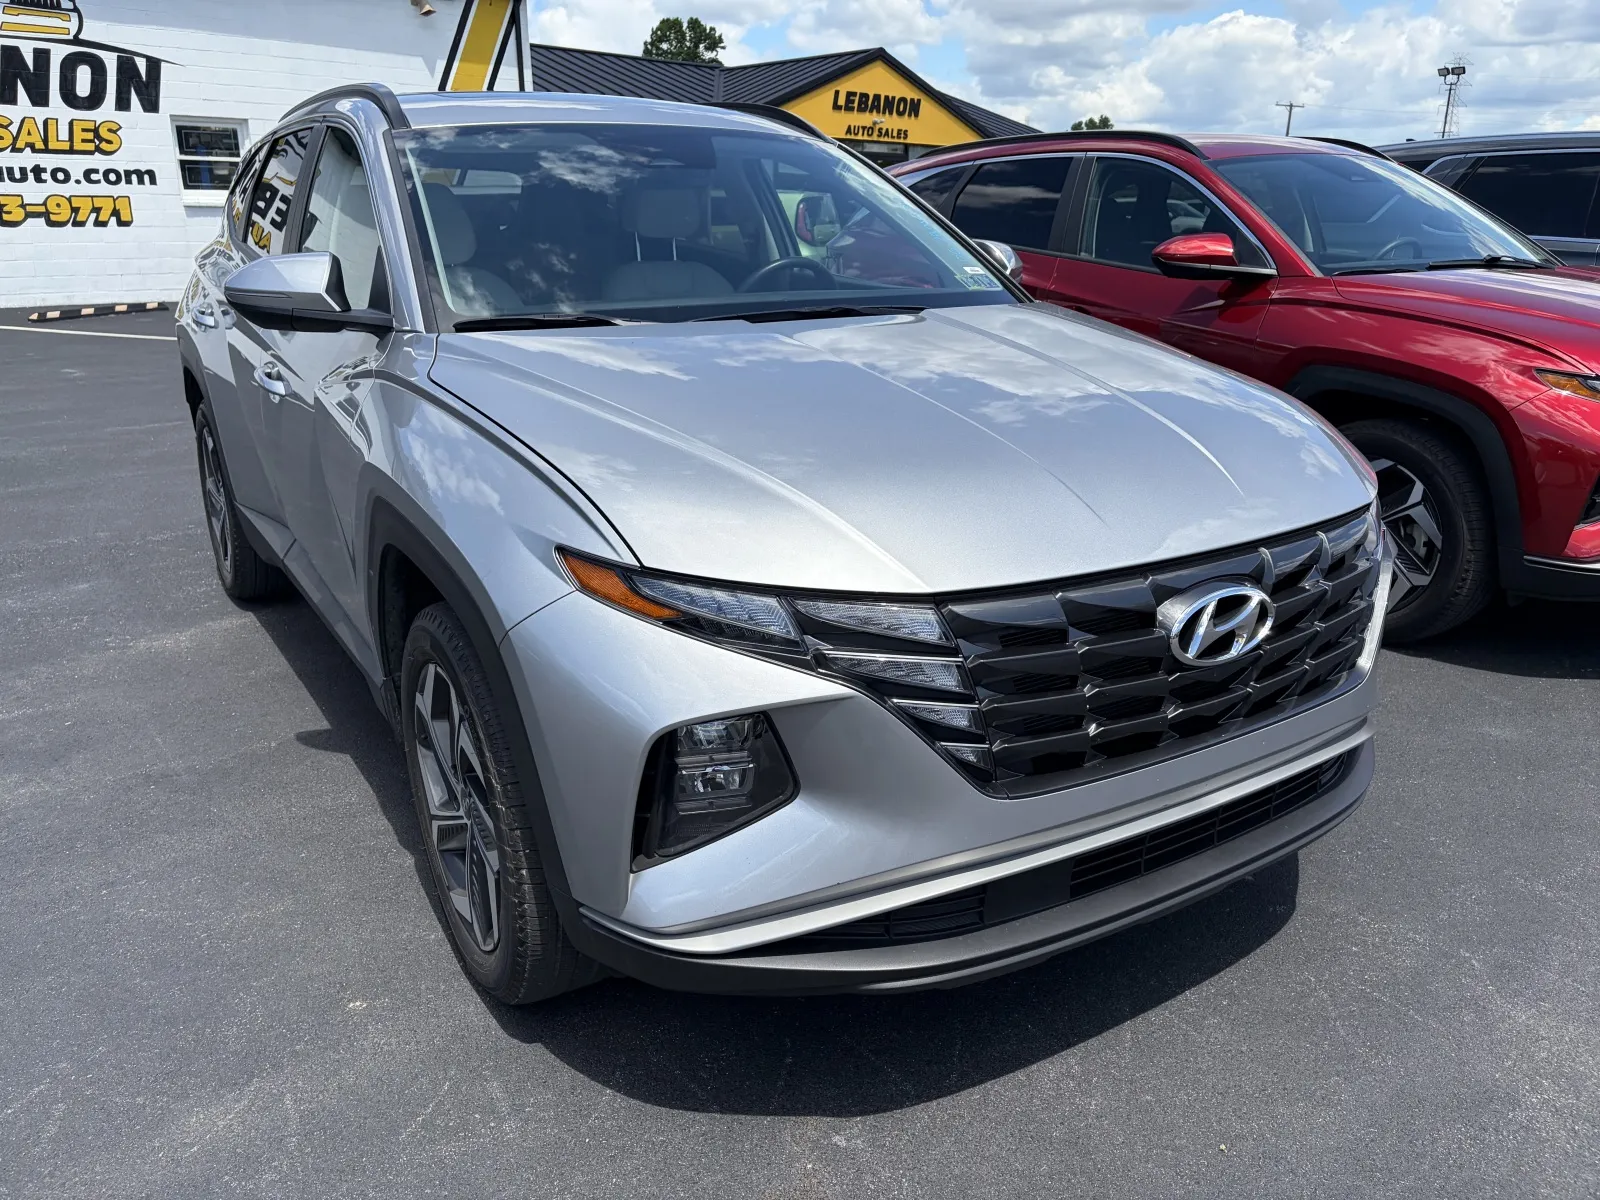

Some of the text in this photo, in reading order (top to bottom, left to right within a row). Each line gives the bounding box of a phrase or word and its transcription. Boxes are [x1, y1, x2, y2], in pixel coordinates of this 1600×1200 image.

[0, 45, 162, 113] NON
[832, 90, 921, 117] LEBANON
[845, 124, 909, 140] AUTO SALES
[0, 163, 157, 186] uto.com
